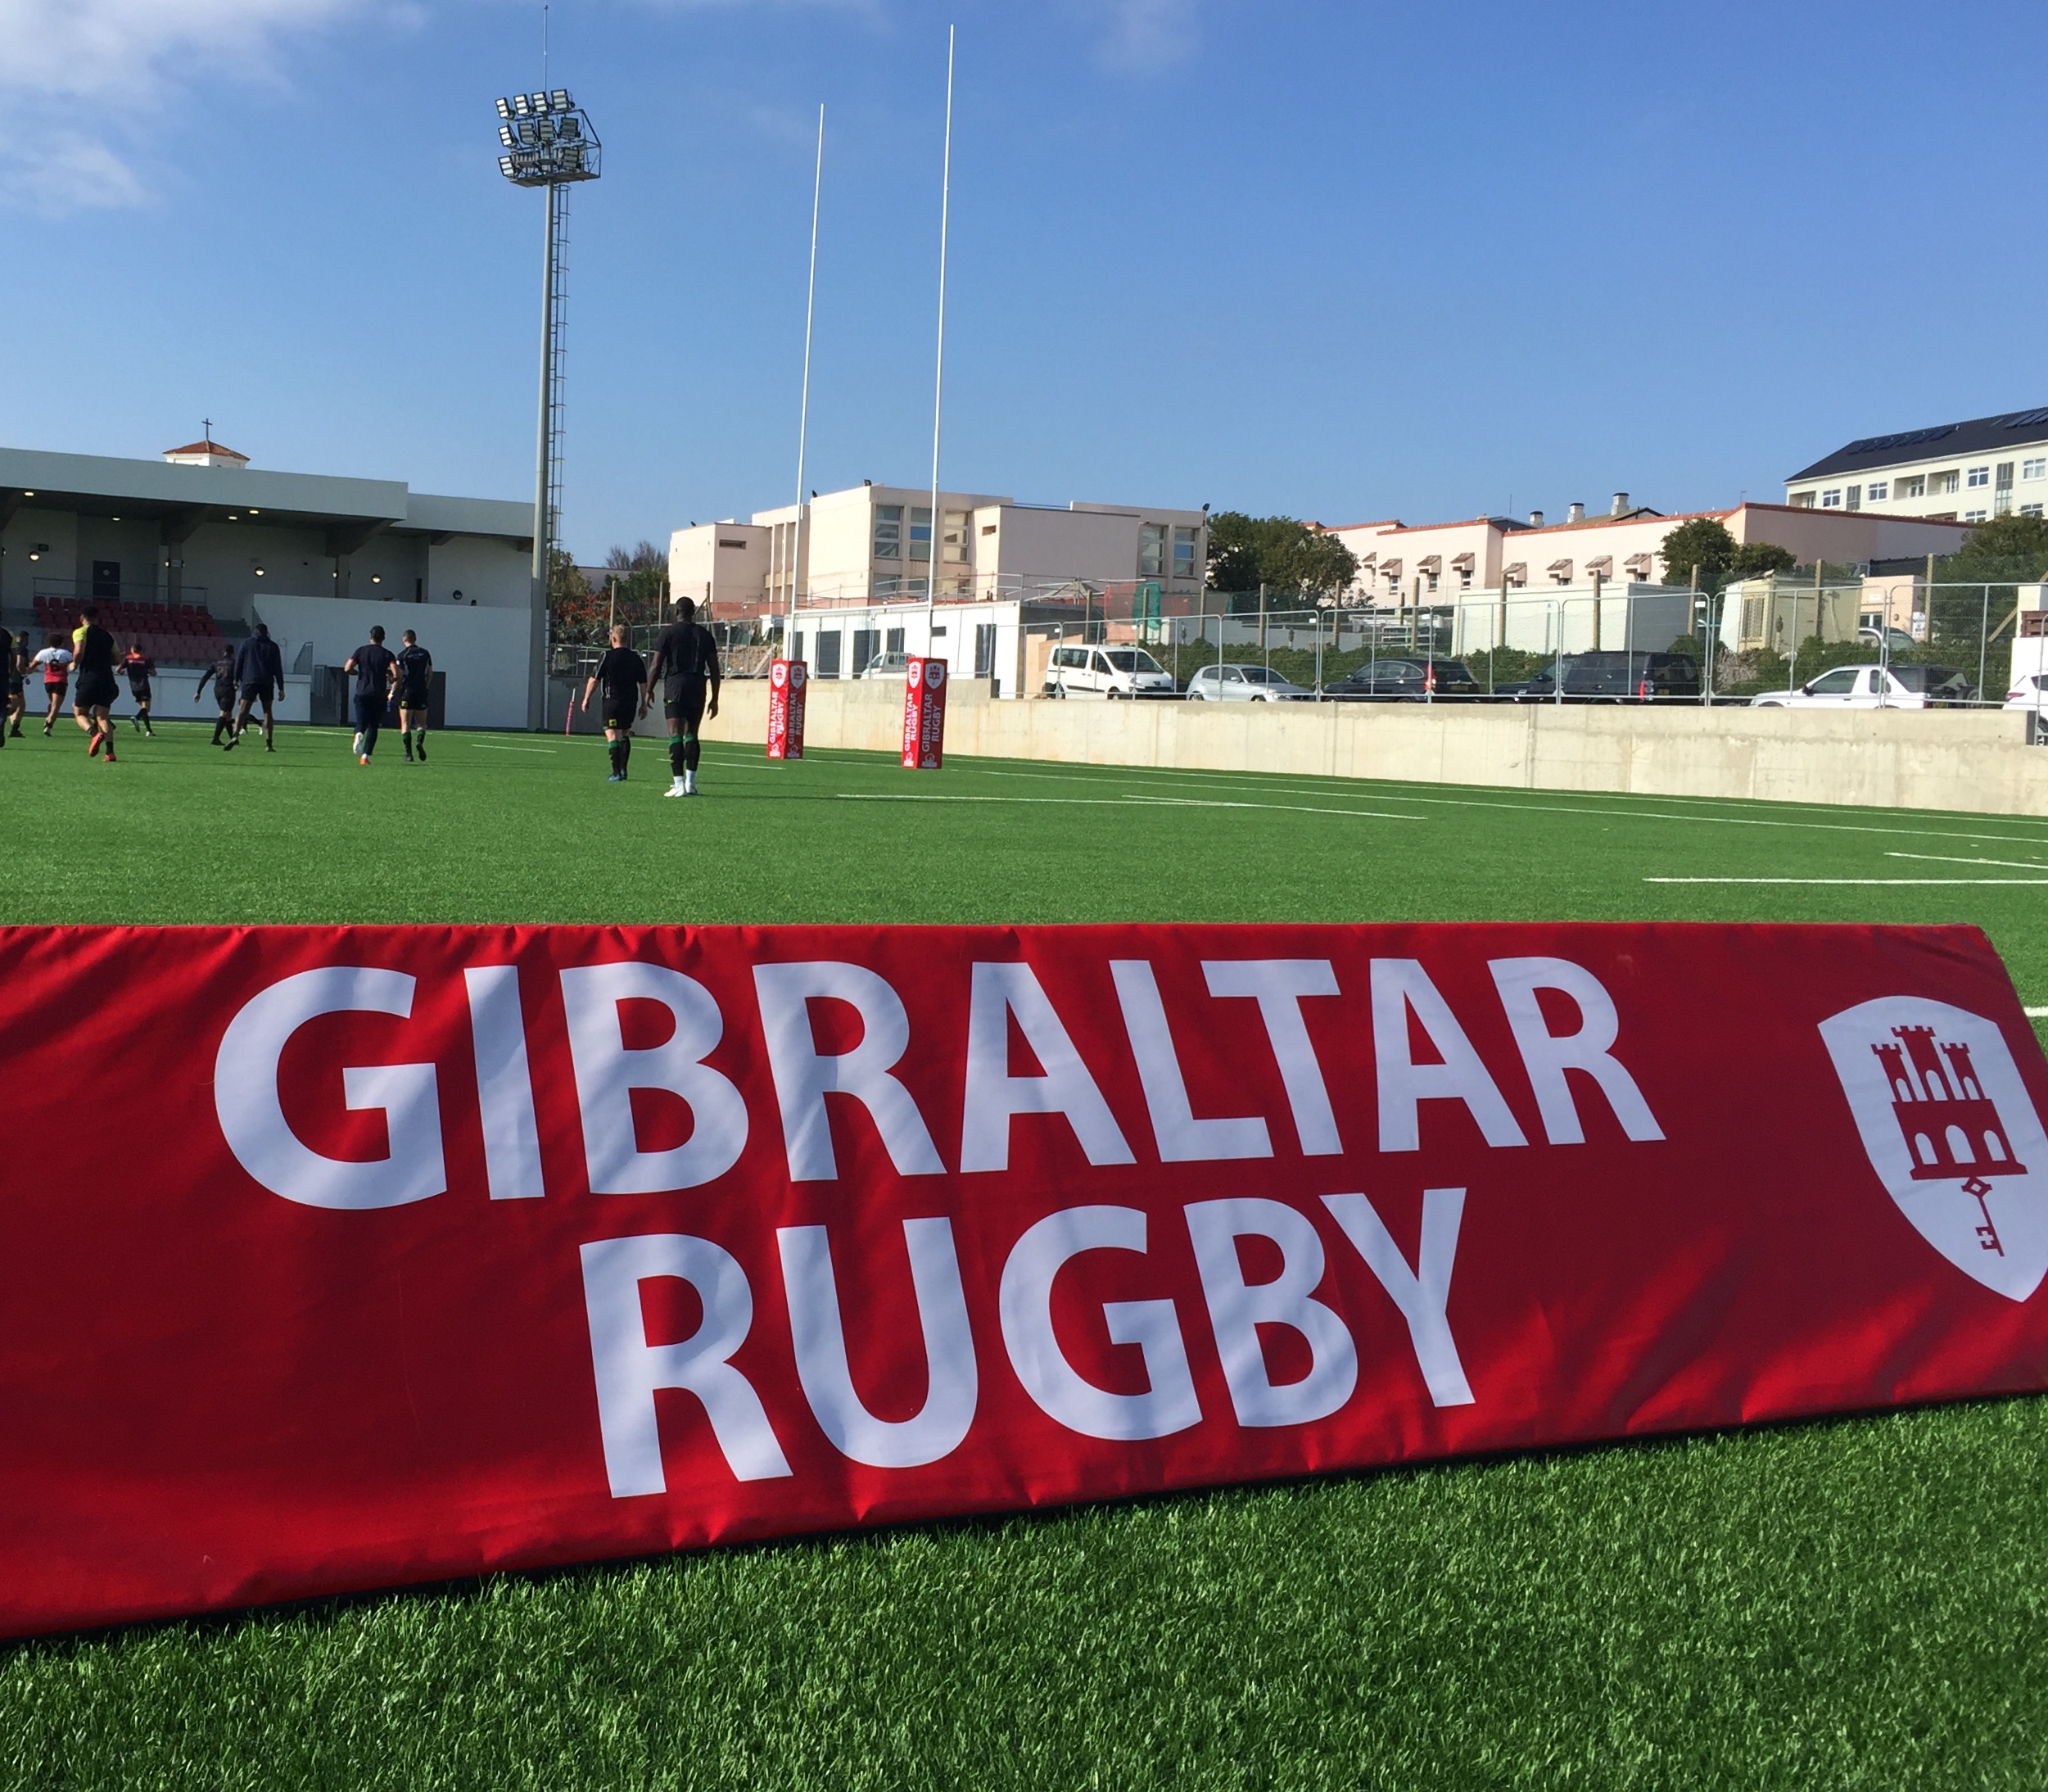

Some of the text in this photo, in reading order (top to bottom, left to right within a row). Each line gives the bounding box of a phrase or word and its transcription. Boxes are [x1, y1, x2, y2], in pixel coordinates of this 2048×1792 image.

[770, 691, 778, 744] GIBRALTAR
[776, 702, 784, 735] RUGBY
[789, 693, 797, 744] GIBRALTAR
[904, 693, 913, 752] GIBRALTAR
[910, 704, 918, 741] RUGBY
[922, 693, 932, 752] GIBRALTAR
[931, 705, 941, 742] RUGBY
[215, 957, 1666, 1210] GIBRALTAR
[580, 1188, 1475, 1498] RUGBY
